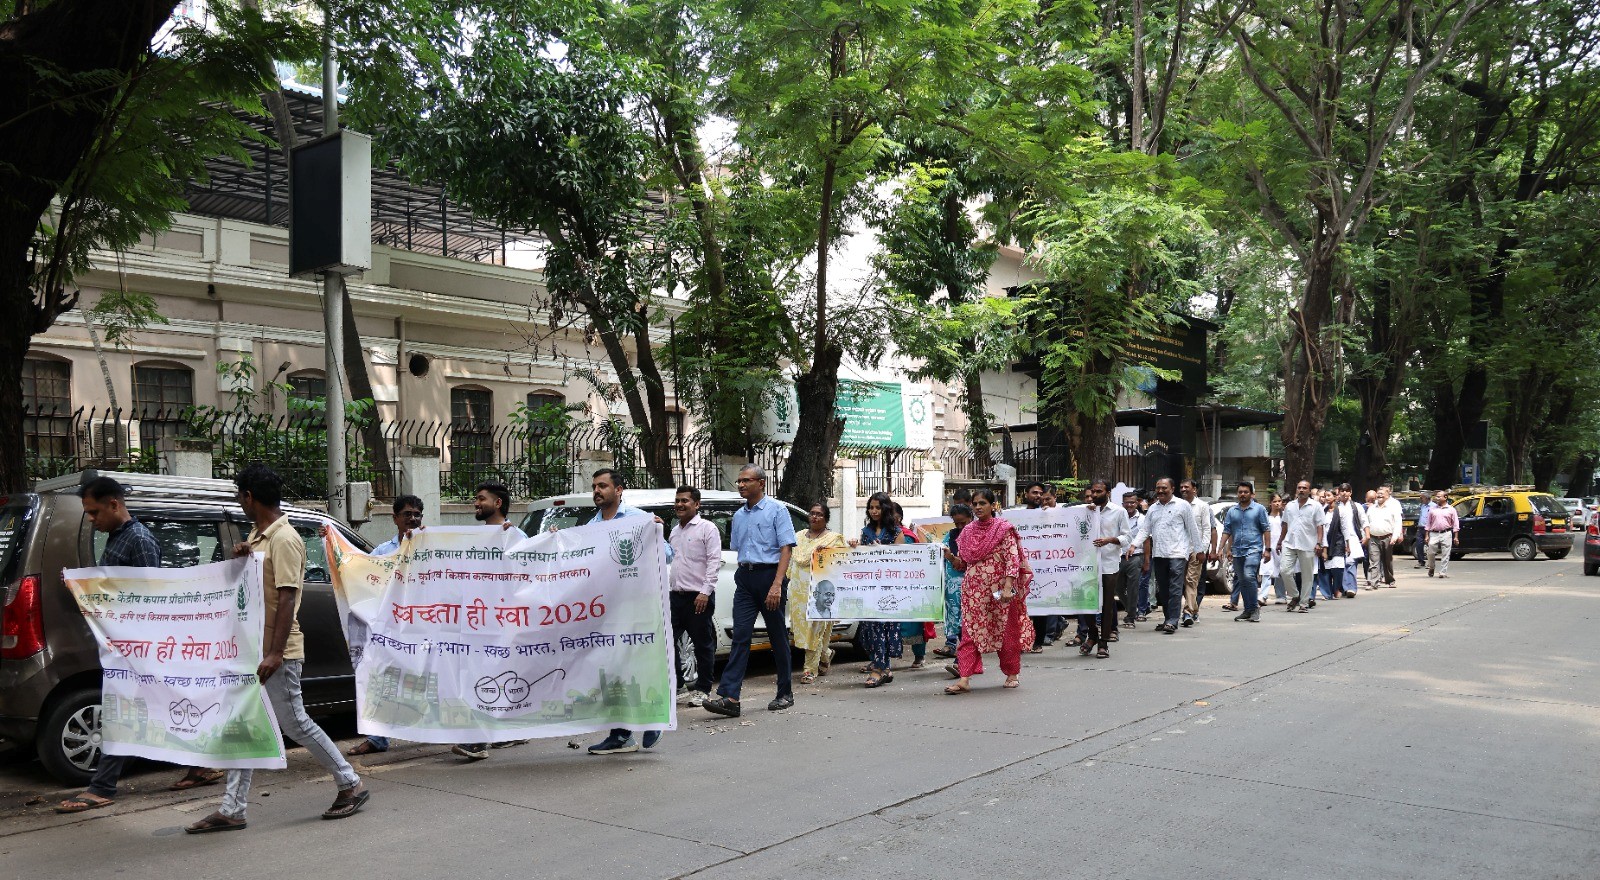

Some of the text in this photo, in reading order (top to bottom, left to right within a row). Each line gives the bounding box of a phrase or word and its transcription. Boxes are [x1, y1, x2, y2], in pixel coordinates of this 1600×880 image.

[434, 550, 462, 560] कपास
[509, 551, 556, 567] अनुसंधान
[1045, 547, 1075, 560] 2026
[903, 569, 926, 580] 2026
[118, 591, 141, 605] केंद्रीय
[143, 595, 167, 604] कपास
[148, 611, 169, 621] किसान
[464, 597, 487, 630] ही
[538, 595, 606, 626] 2026
[157, 637, 176, 663] ही
[181, 637, 211, 660] सेवा
[214, 636, 238, 661] 2026
[483, 645, 510, 659] स्वच्छ
[515, 643, 556, 657] भारत,
[560, 631, 615, 652] विकसित
[620, 632, 655, 646] भारत
[164, 676, 191, 688] स्वच्छ
[195, 677, 216, 690] भारत,
